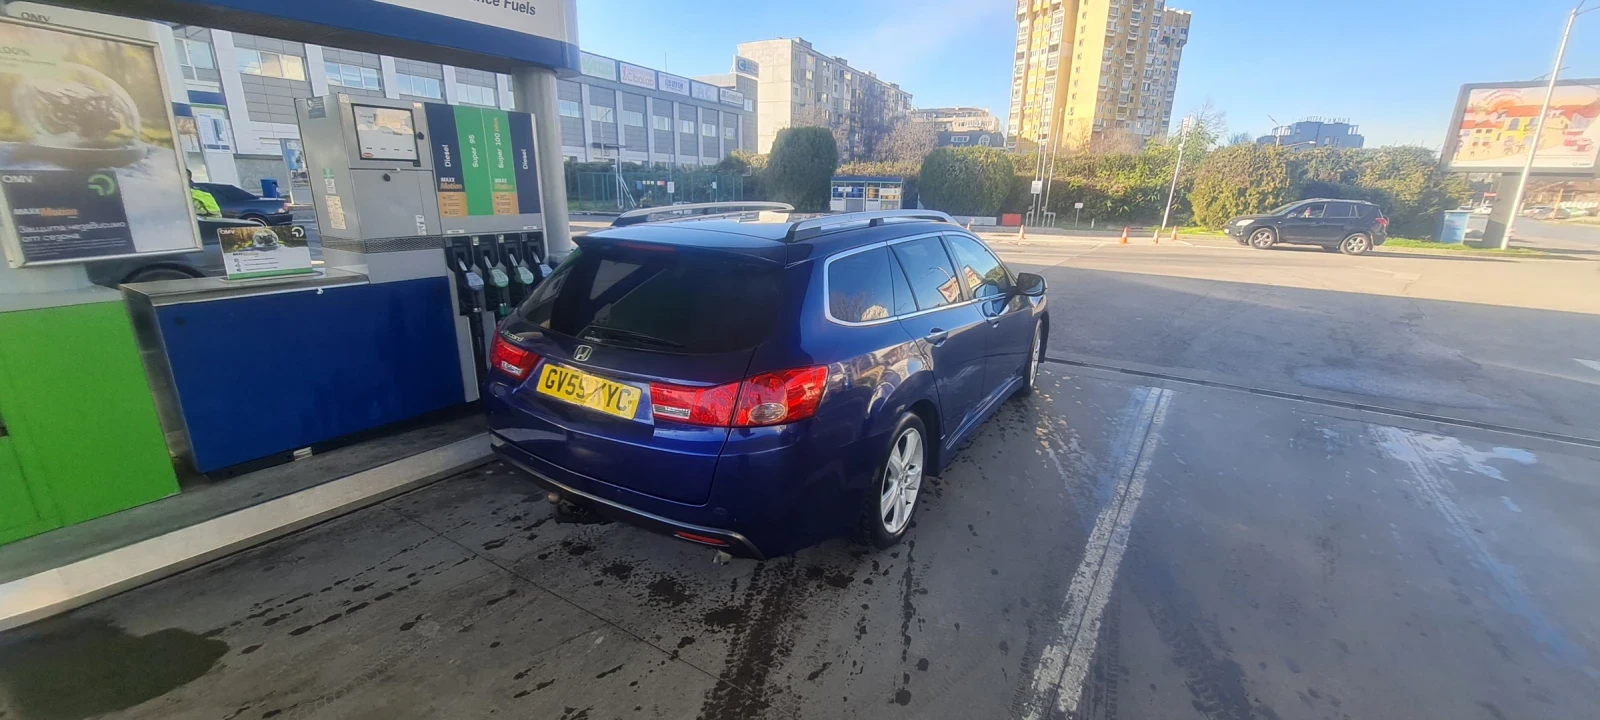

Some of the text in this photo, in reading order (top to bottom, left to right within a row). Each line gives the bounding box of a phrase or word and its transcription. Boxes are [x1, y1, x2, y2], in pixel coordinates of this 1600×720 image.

[504, 0, 536, 16] Fuels
[21, 11, 51, 22] OMV
[494, 132, 502, 146] 100
[441, 144, 452, 168] Diesel
[468, 134, 479, 168] Super 95
[497, 148, 505, 169] Super
[521, 149, 529, 170] Diesel
[3, 175, 33, 184] OMV
[441, 182, 463, 190] Motion
[18, 224, 67, 234] Защита
